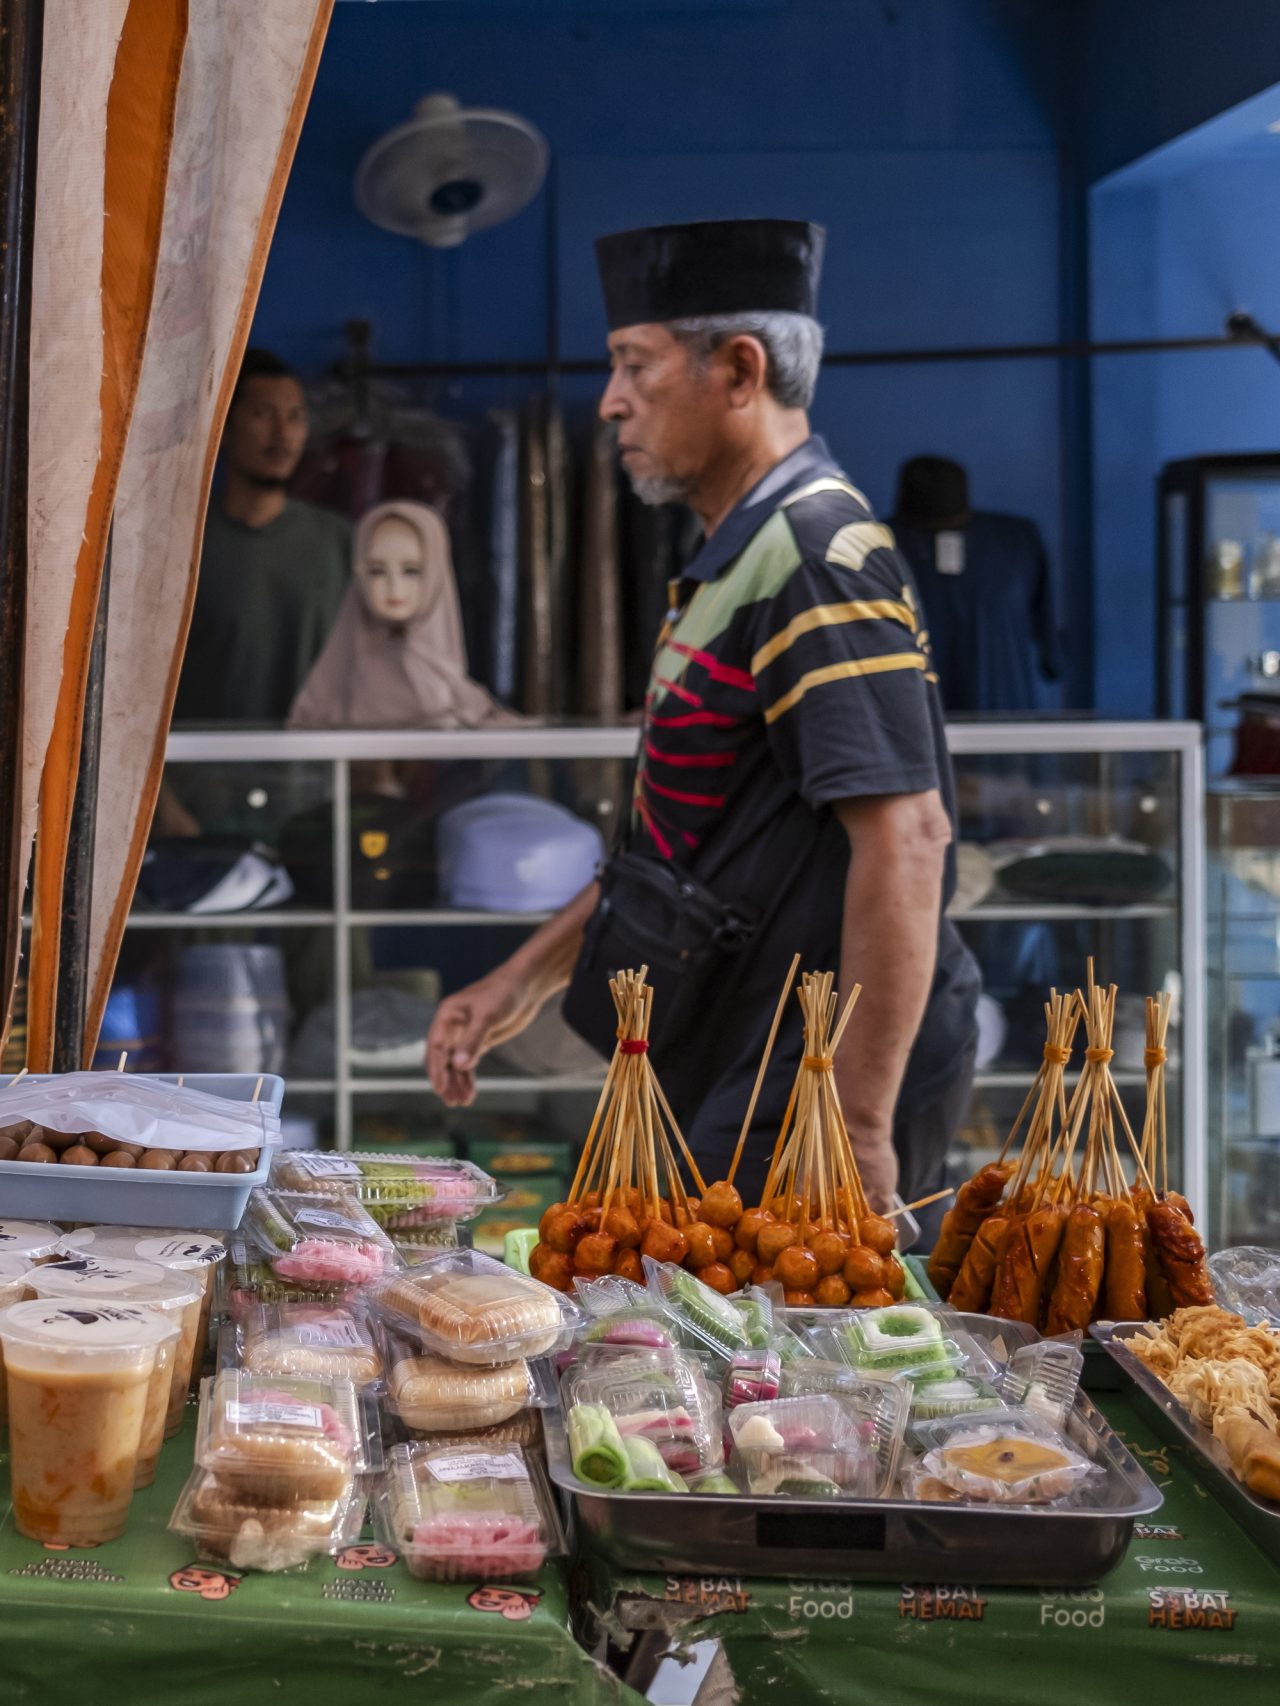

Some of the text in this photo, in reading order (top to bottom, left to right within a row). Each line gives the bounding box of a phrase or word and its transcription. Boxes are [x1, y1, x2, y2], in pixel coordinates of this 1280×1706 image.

[1134, 1556, 1198, 1566] Grab
[1140, 1563, 1204, 1573] Food
[790, 1596, 853, 1619] Food
[898, 1598, 987, 1621] HEMAT
[1040, 1604, 1105, 1628] Food
[1148, 1607, 1238, 1629] HEMAT
